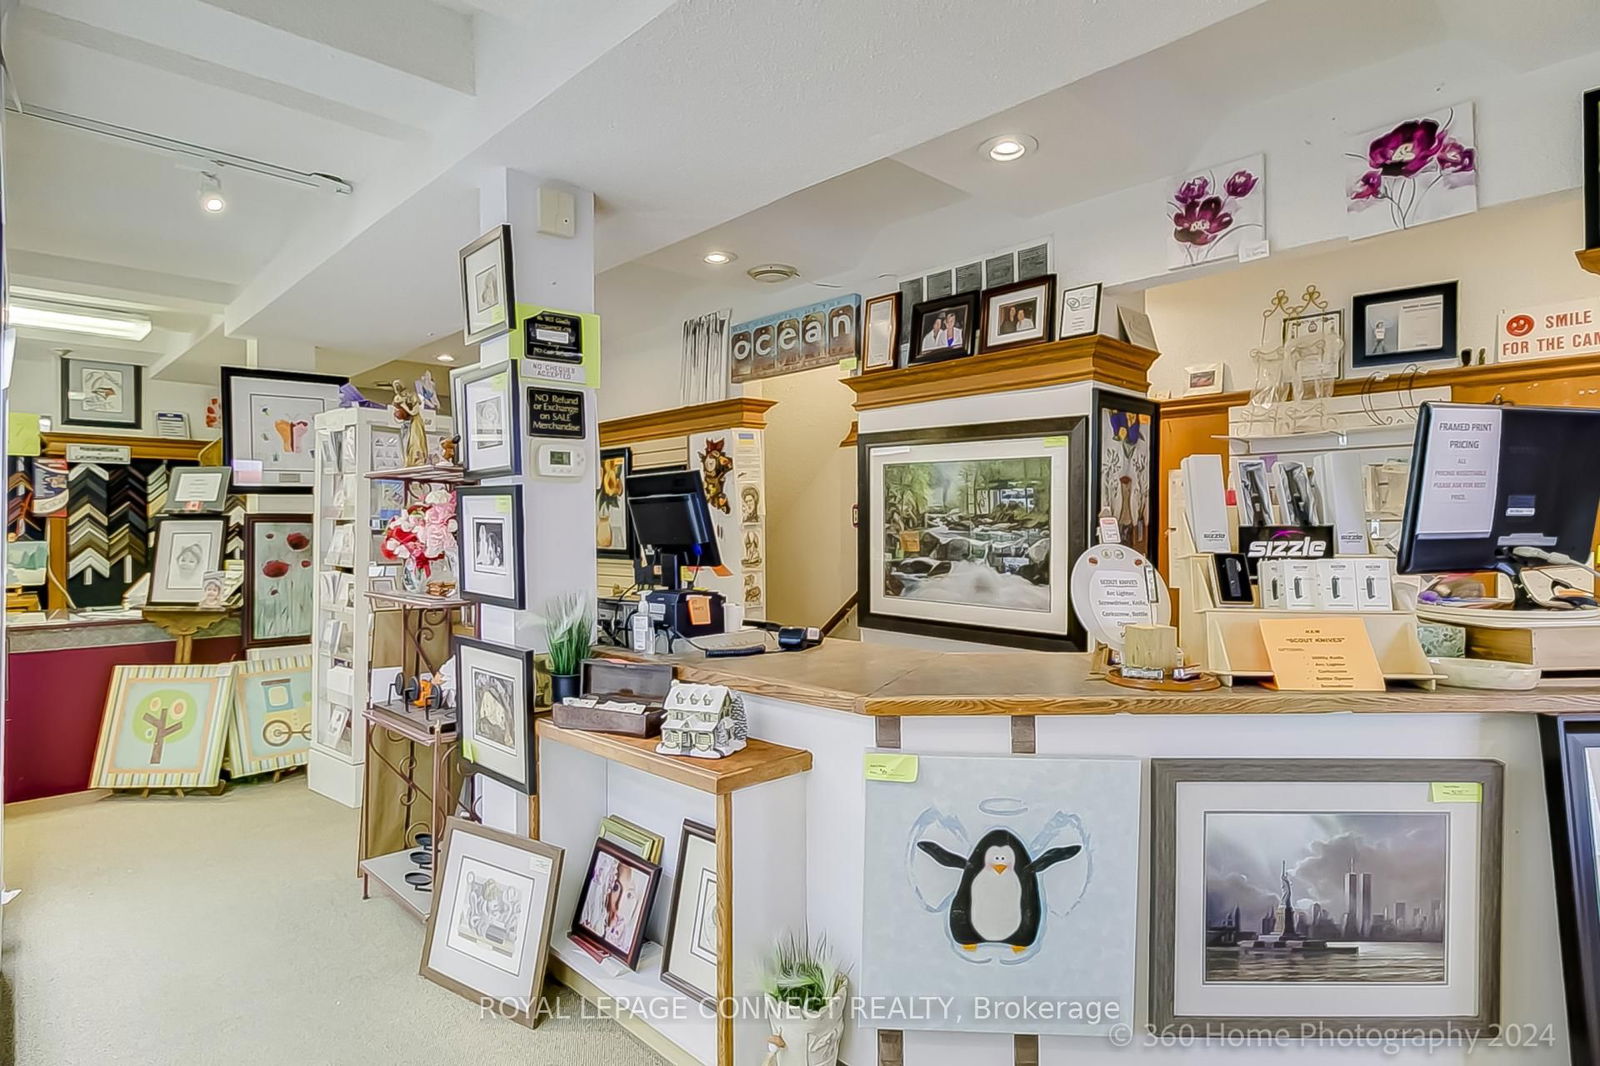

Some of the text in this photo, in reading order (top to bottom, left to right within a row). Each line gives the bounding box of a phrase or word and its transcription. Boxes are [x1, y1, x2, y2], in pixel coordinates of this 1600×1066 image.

[1545, 310, 1592, 329] SMILE
[733, 314, 851, 361] ocean
[1502, 341, 1529, 356] FOR
[1536, 336, 1565, 352] THE
[534, 394, 579, 405] NO Refund
[543, 403, 579, 414] Exchange
[552, 413, 571, 421] SALE
[532, 421, 581, 431] Merchandise
[1439, 423, 1492, 431] FRAMED PRINT
[1449, 440, 1479, 449] PRICING
[1248, 536, 1327, 558] sizzle
